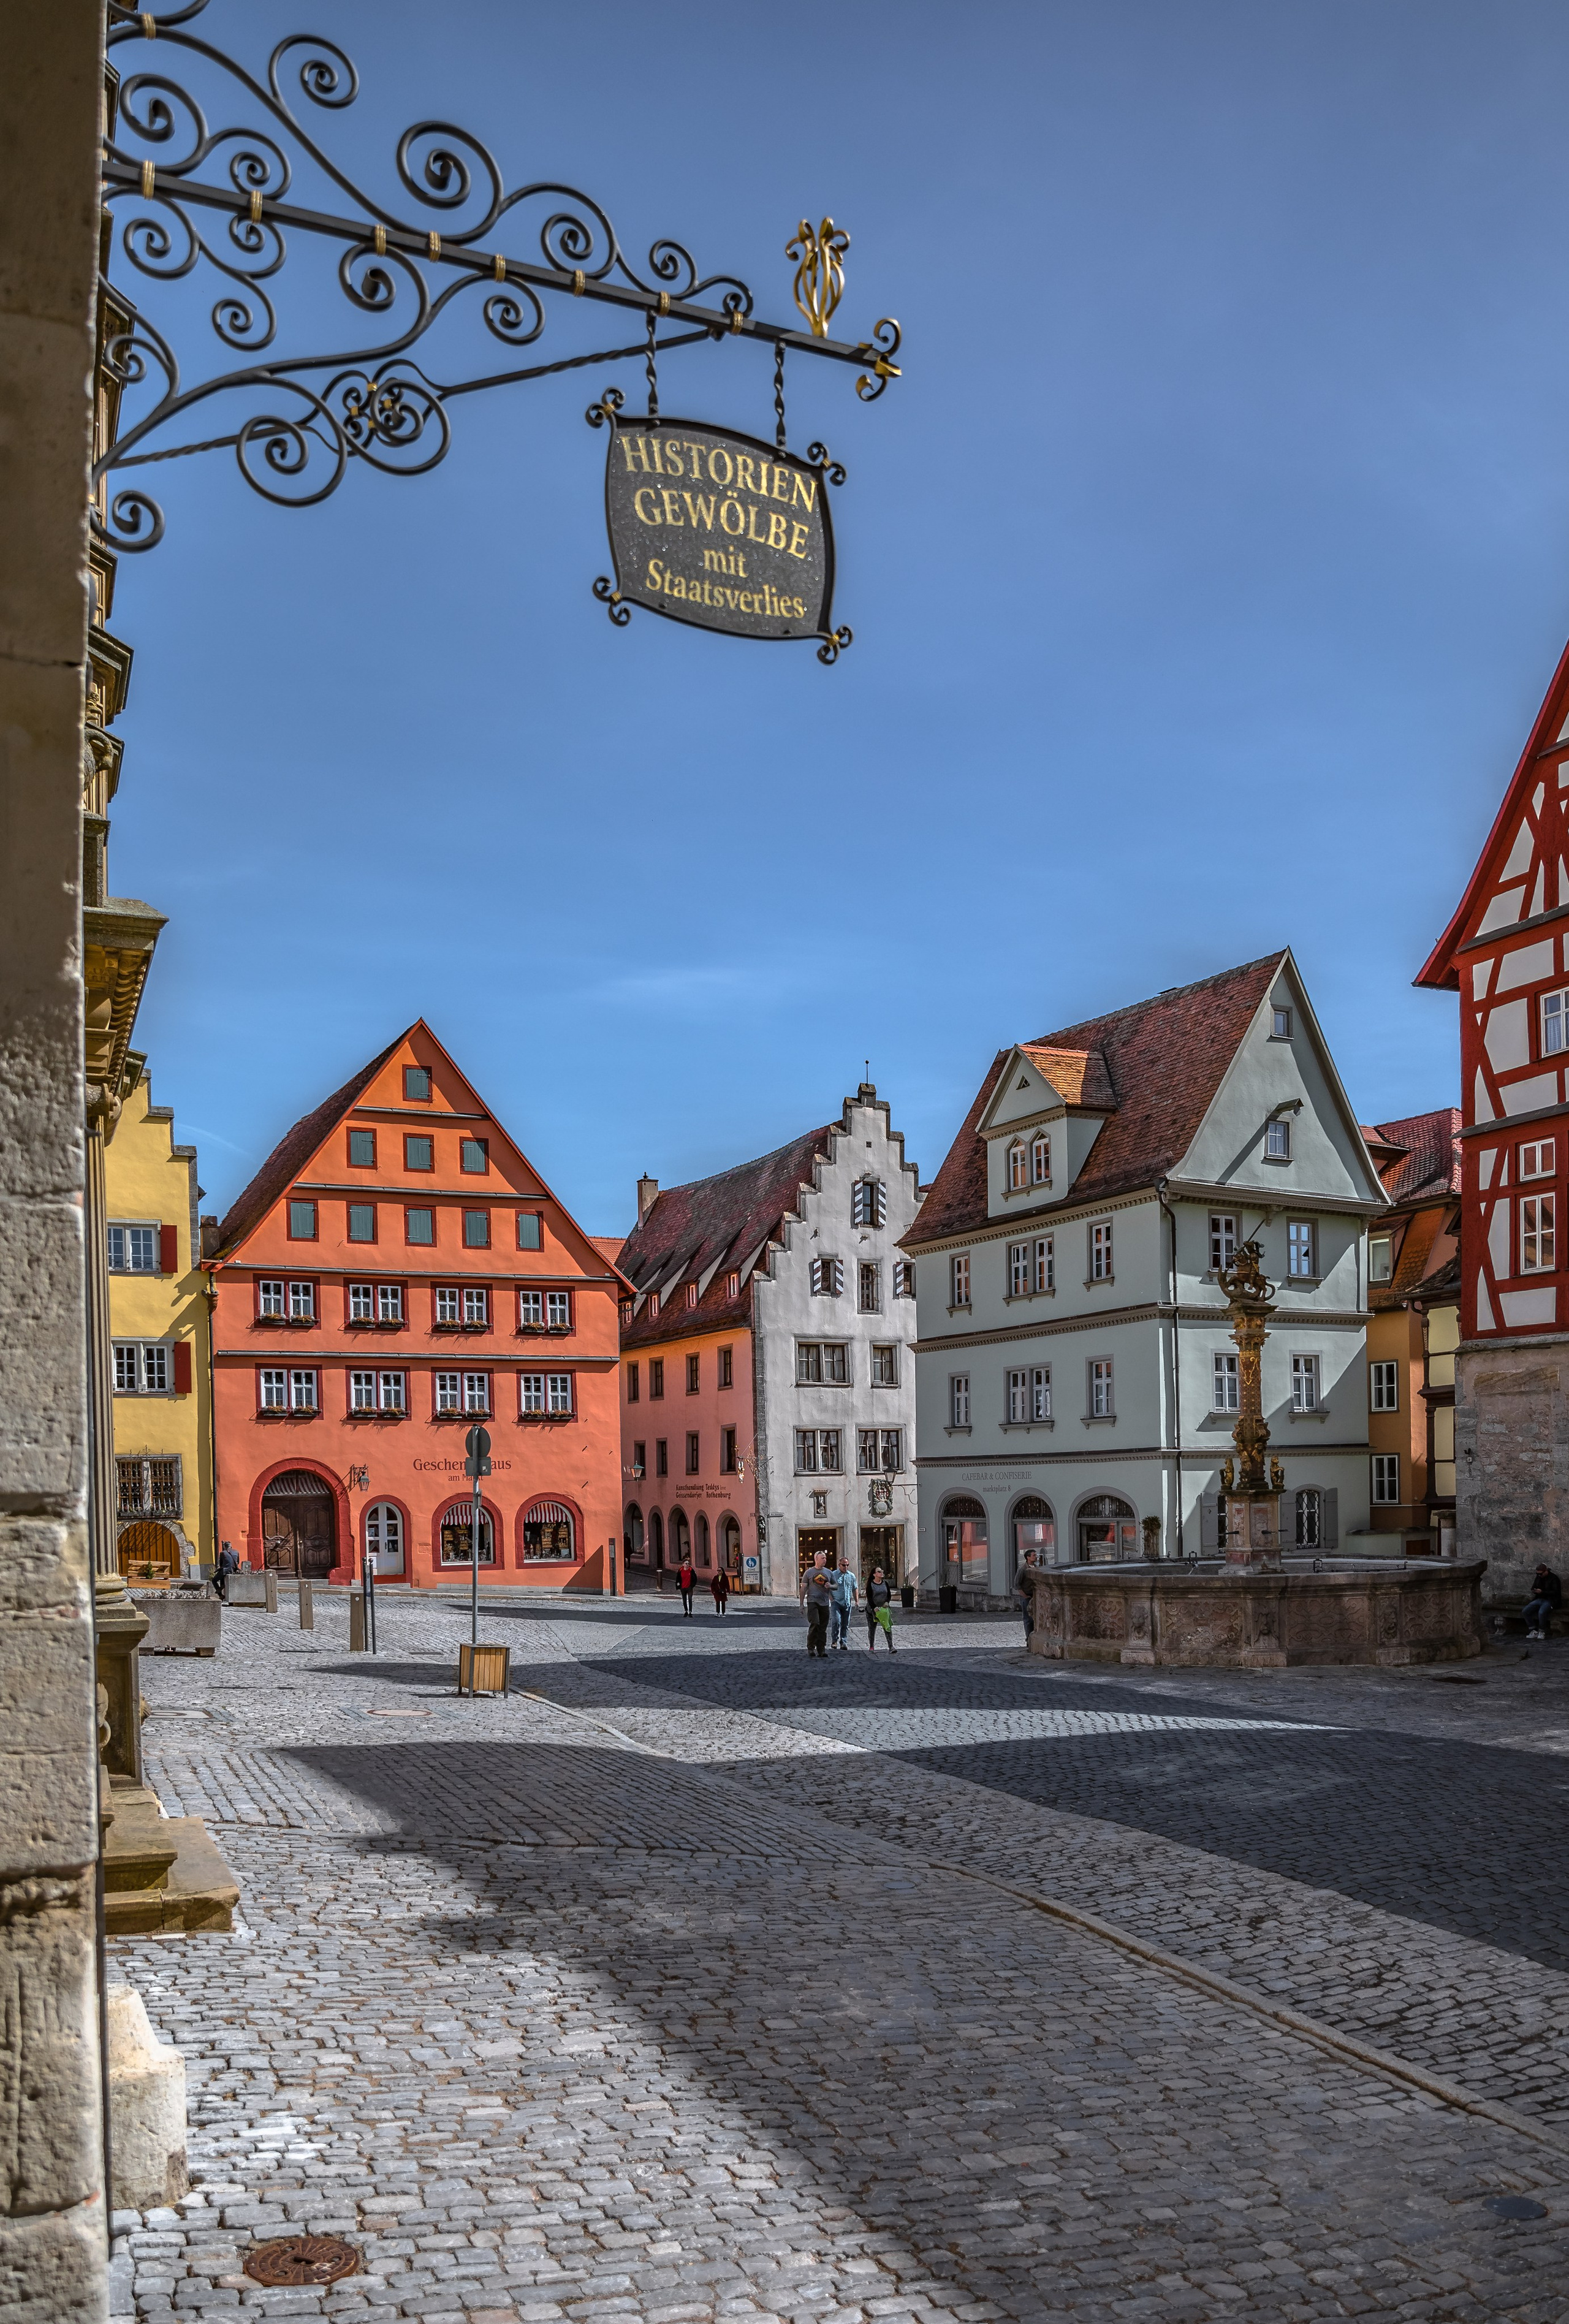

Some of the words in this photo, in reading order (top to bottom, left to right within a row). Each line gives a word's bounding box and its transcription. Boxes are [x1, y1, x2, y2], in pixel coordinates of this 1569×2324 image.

[621, 436, 818, 513] HISTORIEN
[634, 488, 810, 559] GEWÖLBE
[645, 558, 806, 618] Staatsverlies
[704, 545, 748, 578] mit
[995, 1471, 1031, 1480] CONFISERIE
